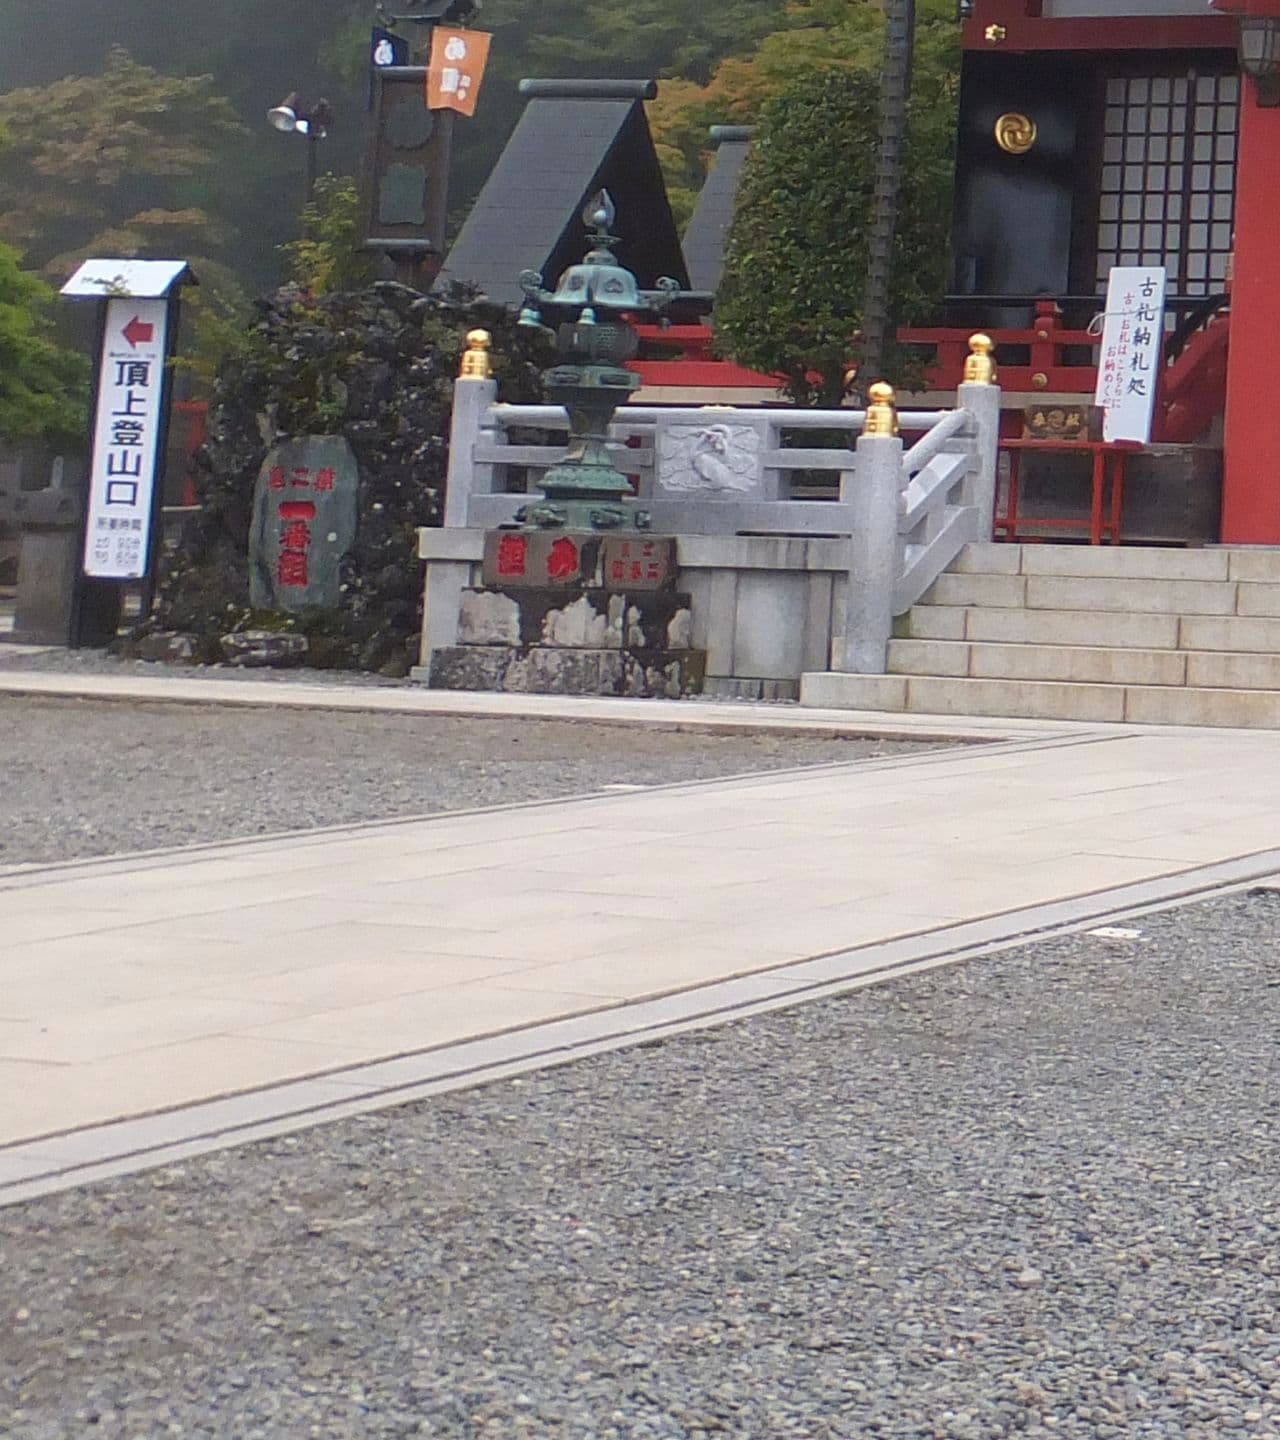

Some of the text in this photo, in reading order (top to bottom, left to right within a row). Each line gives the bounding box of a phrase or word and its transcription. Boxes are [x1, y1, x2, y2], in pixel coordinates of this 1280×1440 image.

[1127, 276, 1158, 396] 古札納札処
[105, 360, 151, 507] 頂上登山口
